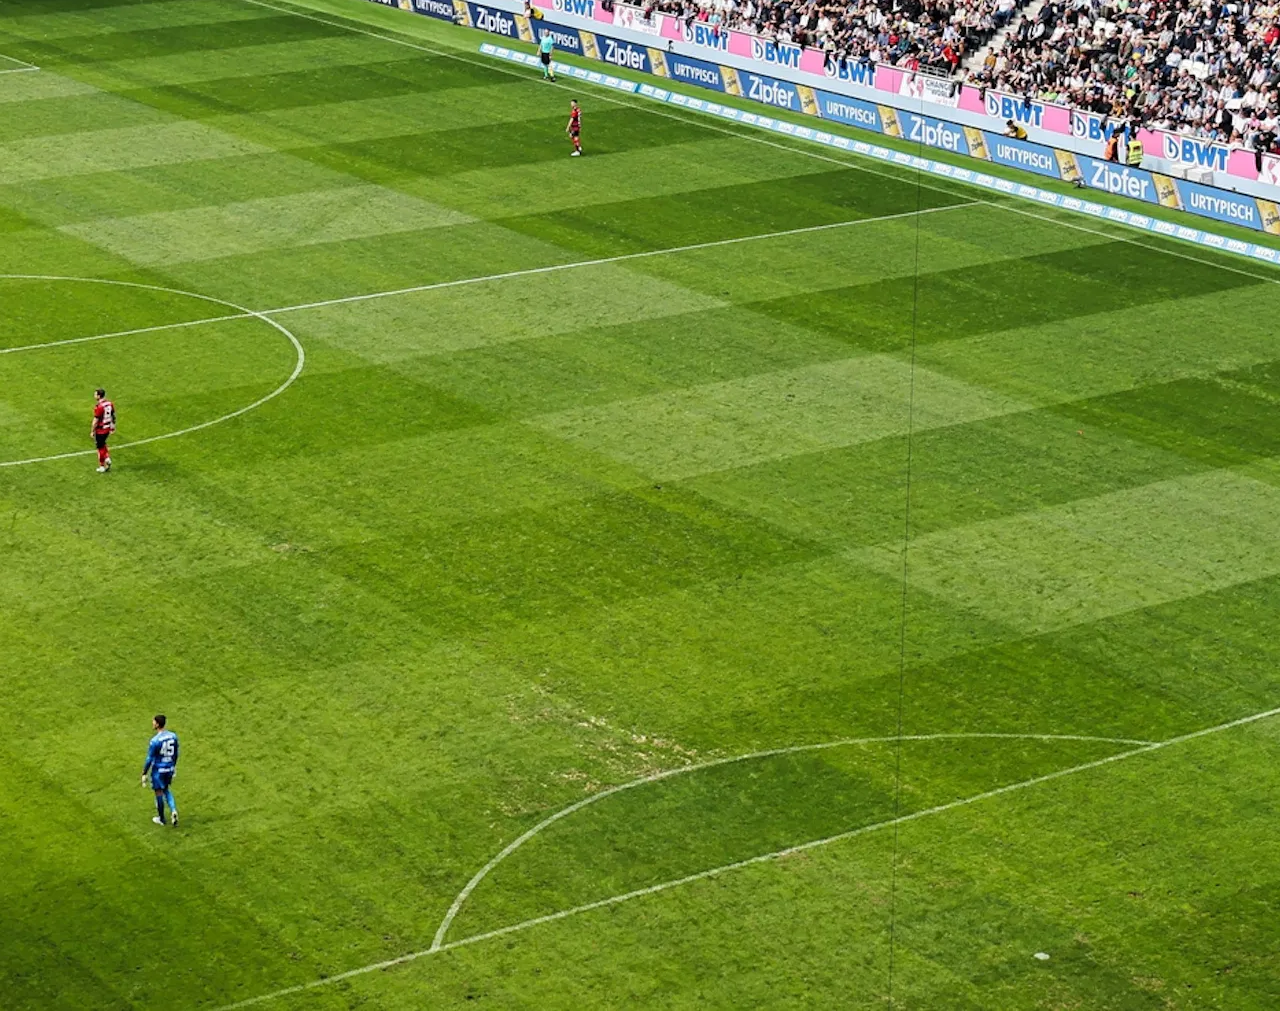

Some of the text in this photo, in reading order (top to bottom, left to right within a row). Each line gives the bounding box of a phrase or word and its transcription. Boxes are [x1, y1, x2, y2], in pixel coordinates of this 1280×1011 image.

[477, 7, 513, 36] Zipfer
[605, 39, 646, 70] Zipfer
[765, 44, 801, 69] BWT
[674, 62, 719, 85] URTYPISCH
[749, 75, 795, 108] Zipfer
[826, 100, 876, 126] URTYPISCH
[1001, 97, 1043, 128] BWT
[910, 115, 961, 151] Zipfer
[997, 143, 1053, 171] URTYPISCH
[1181, 138, 1229, 171] BWT
[1091, 162, 1149, 199] Zipfer
[1190, 192, 1254, 221] URTYPISCH
[160, 739, 175, 756] 45
